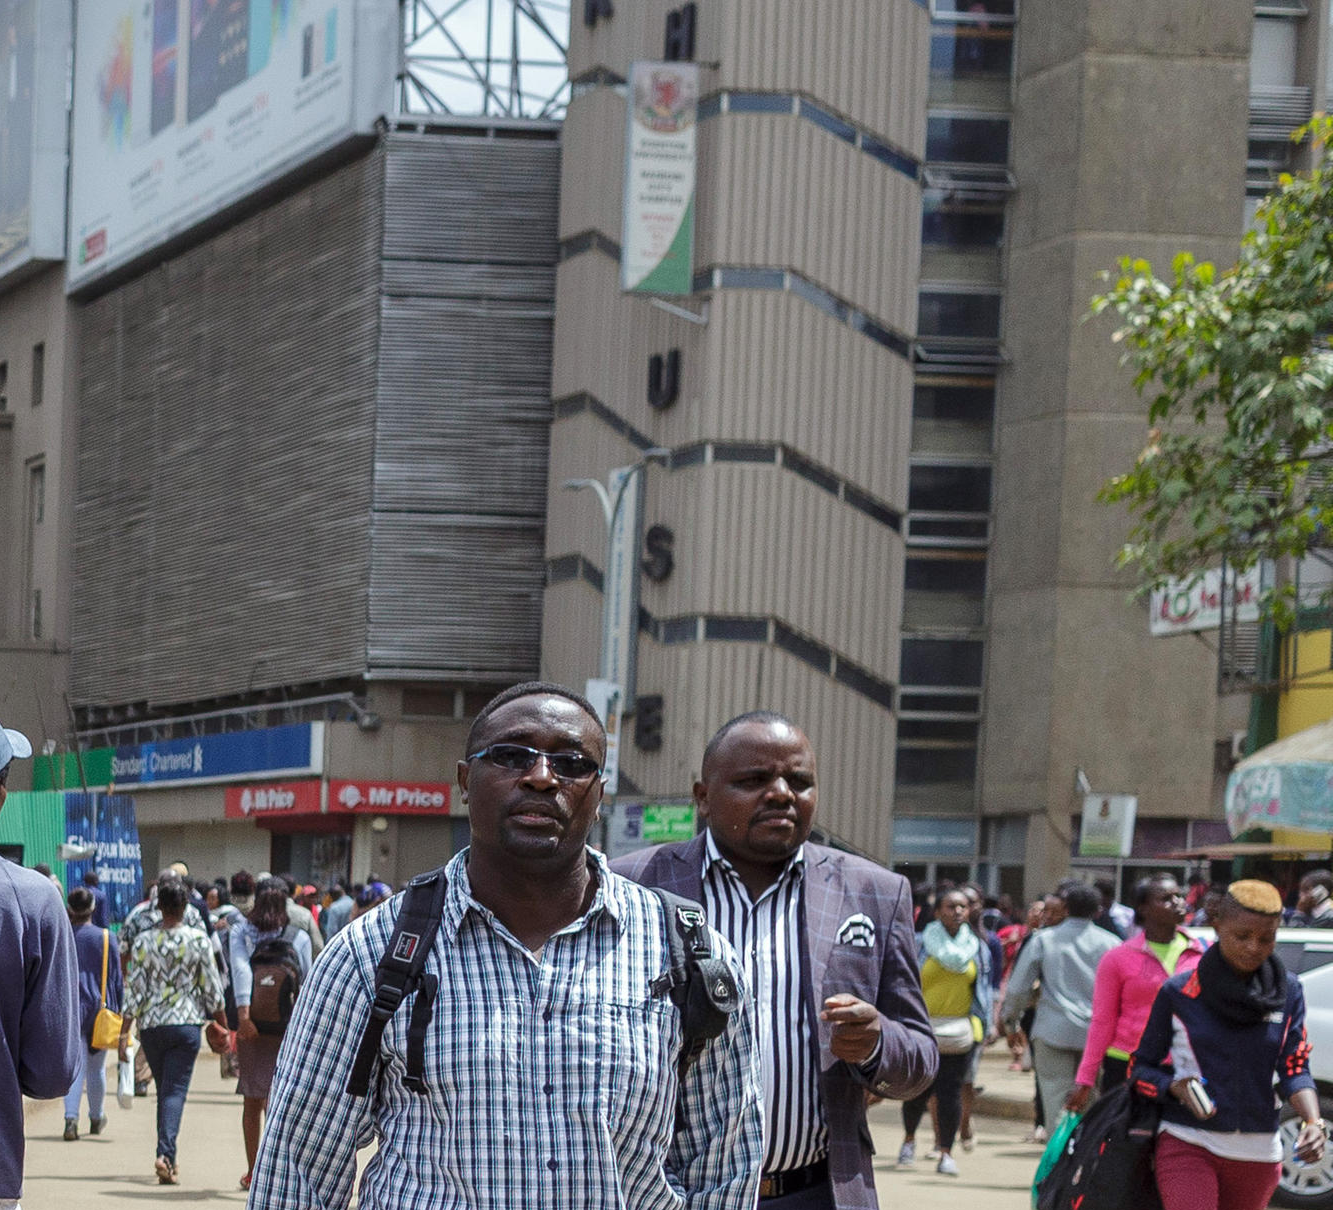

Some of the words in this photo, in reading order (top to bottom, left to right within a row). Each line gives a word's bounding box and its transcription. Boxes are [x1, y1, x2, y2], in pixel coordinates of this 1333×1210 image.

[111, 755, 148, 777] Standard
[149, 748, 192, 773] Chartered
[369, 787, 394, 805] Mr
[396, 788, 445, 808] Price
